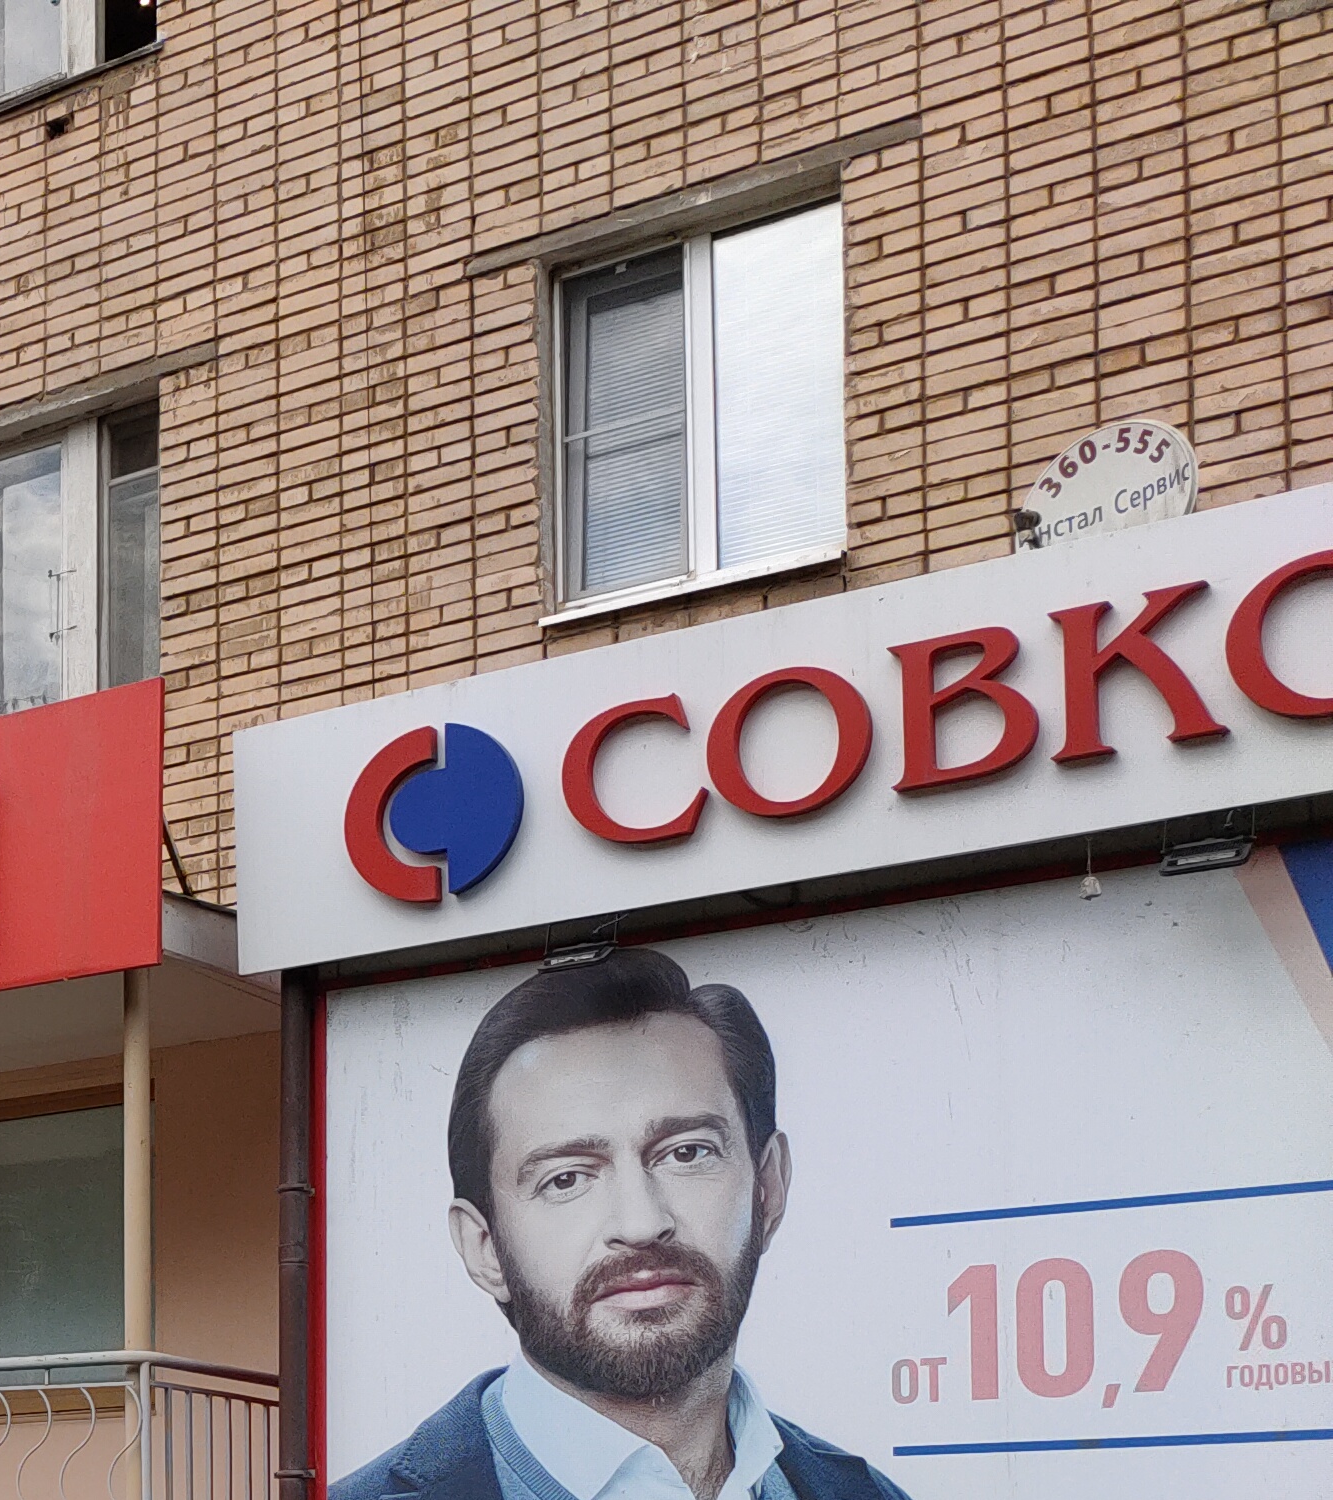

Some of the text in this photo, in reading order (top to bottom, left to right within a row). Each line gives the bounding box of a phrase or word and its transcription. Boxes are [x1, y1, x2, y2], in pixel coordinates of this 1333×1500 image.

[1038, 426, 1172, 499] 360-555
[1113, 462, 1191, 515] Сервис
[947, 1249, 1204, 1409] 10,9
[1224, 1283, 1288, 1352] %
